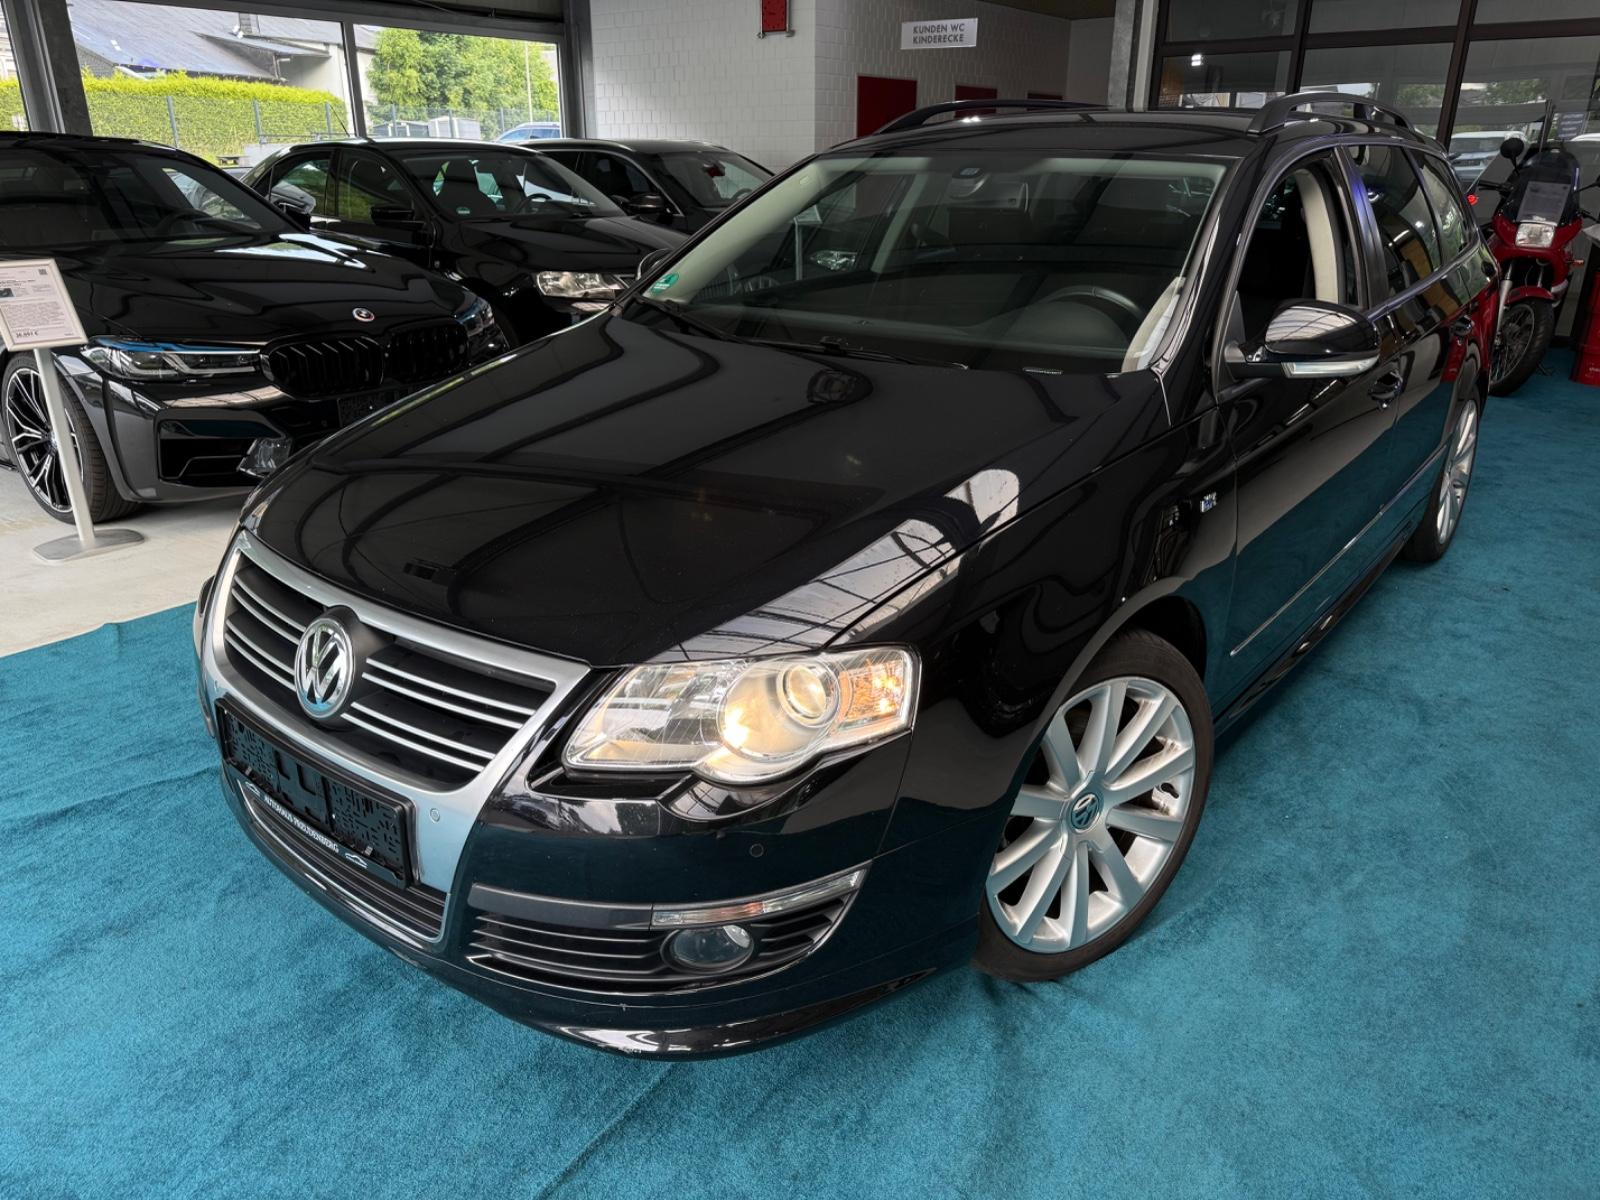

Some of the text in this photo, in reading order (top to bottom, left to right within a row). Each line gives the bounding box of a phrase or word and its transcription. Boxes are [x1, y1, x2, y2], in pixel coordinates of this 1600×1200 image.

[913, 23, 965, 34] KUNDEN WC
[912, 34, 965, 44] KINDERECKE
[299, 622, 349, 710] VW
